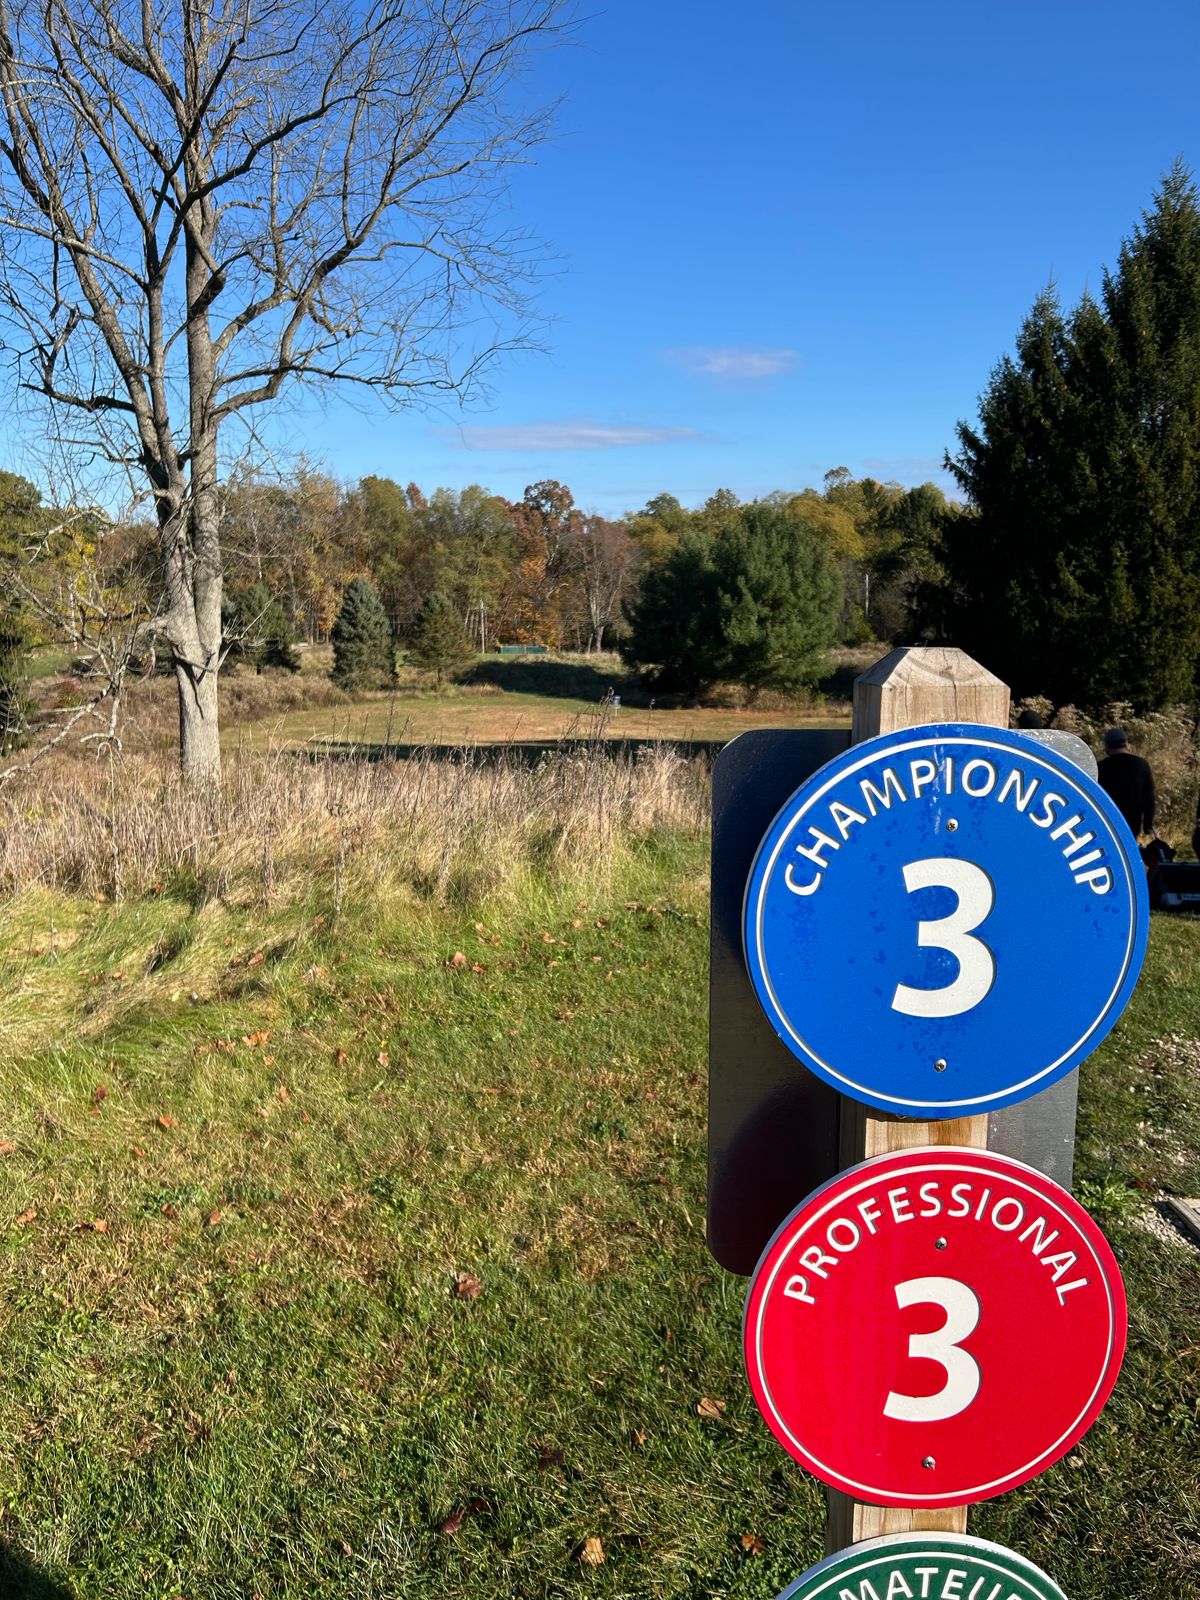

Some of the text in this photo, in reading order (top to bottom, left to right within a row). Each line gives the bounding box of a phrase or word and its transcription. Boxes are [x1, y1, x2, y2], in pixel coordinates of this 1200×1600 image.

[784, 757, 1114, 896] CHAMPIONSHIP
[890, 857, 995, 1018] 3
[783, 1182, 1090, 1306] PROFESSIONAL
[882, 1276, 981, 1422] 3
